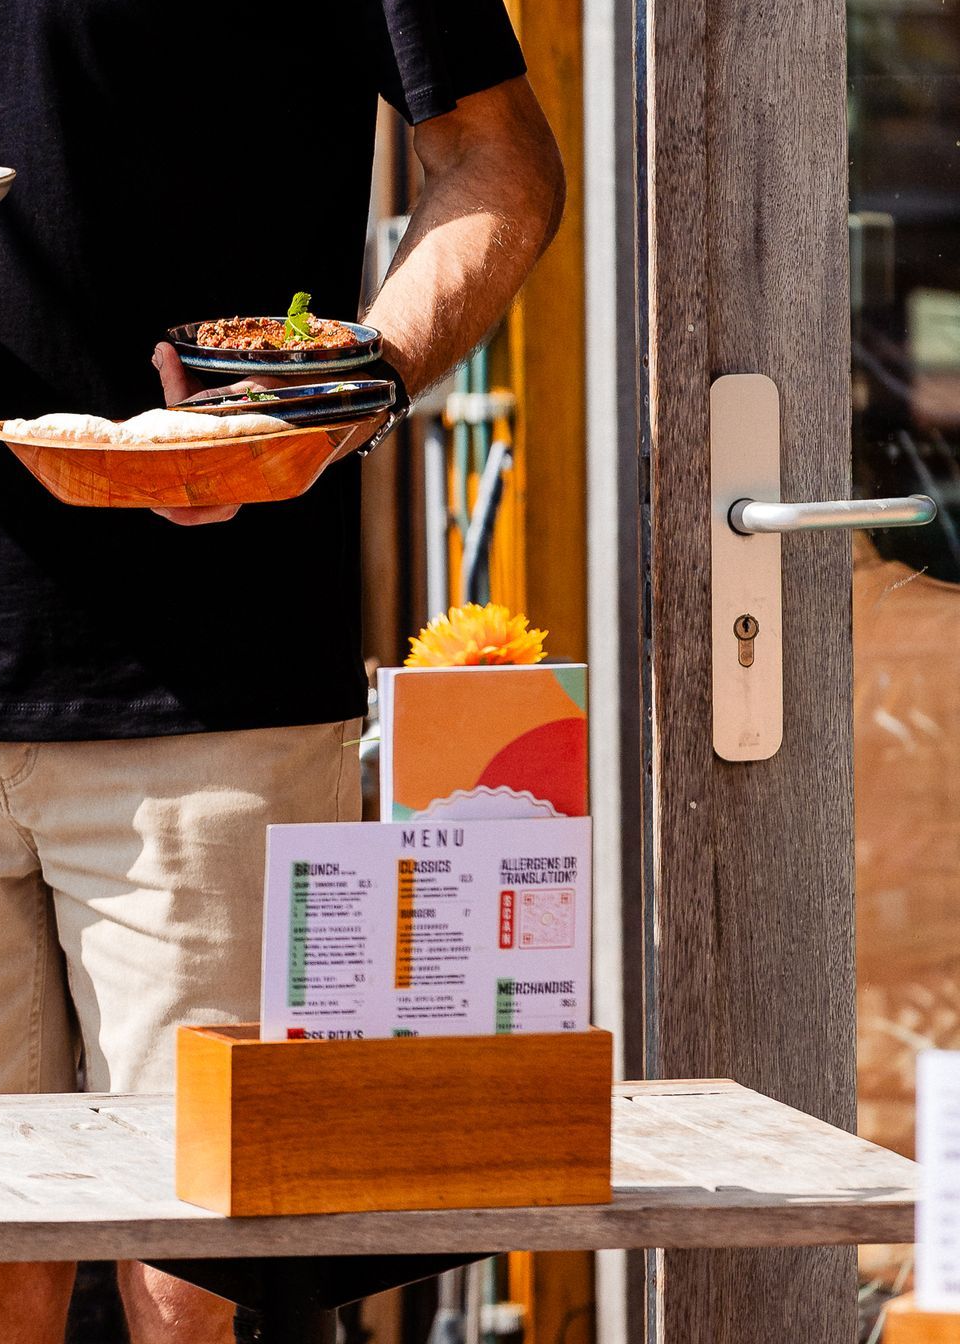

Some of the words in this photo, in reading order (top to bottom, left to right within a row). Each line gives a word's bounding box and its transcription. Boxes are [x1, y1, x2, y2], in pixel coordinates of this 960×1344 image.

[401, 829, 464, 848] MENU
[294, 861, 340, 876] BRUNCH
[399, 859, 452, 874] CLASSICS
[501, 857, 562, 871] ALLERGENS
[564, 856, 578, 869] OR
[500, 871, 579, 885] TRANSLATION?
[497, 979, 576, 996] MERCHANDISE
